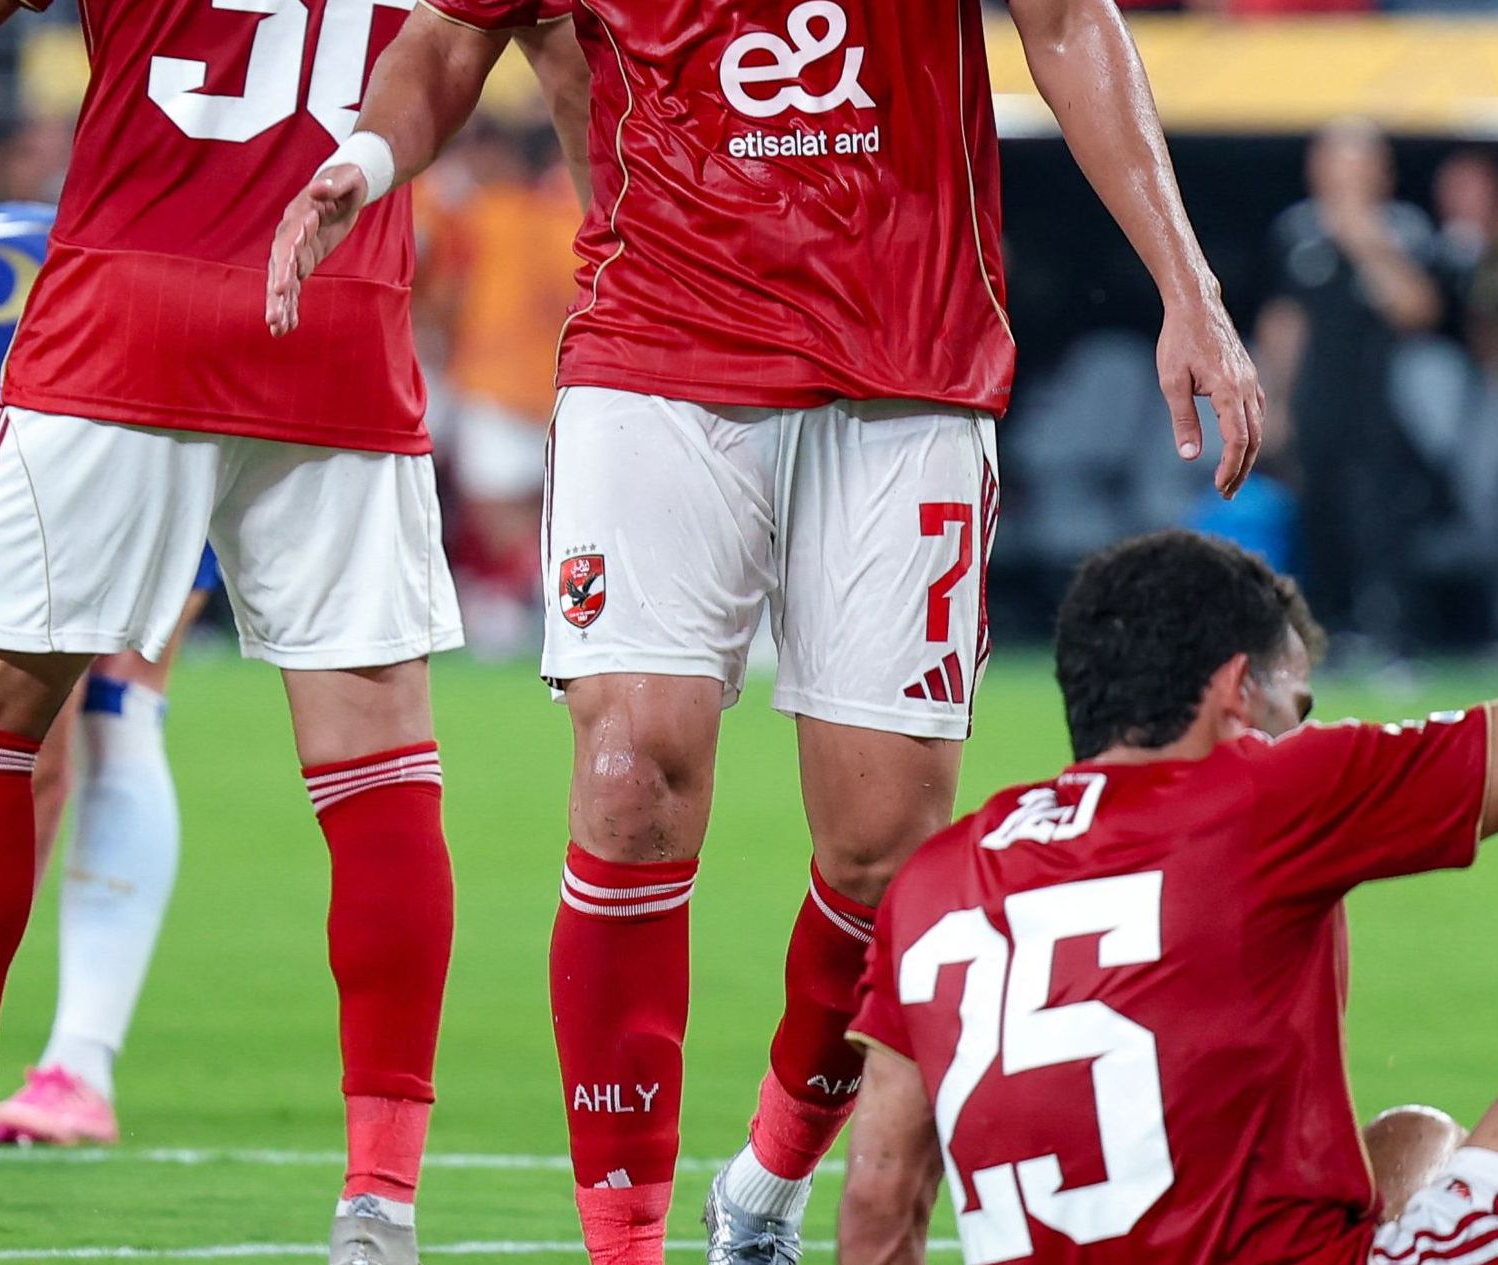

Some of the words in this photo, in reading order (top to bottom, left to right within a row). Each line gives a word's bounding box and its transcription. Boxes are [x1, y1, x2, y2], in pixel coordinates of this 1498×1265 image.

[728, 129, 828, 158] etisalat
[919, 502, 973, 642] 7
[573, 1082, 659, 1113] AHLY
[898, 869, 1175, 1265] 25
